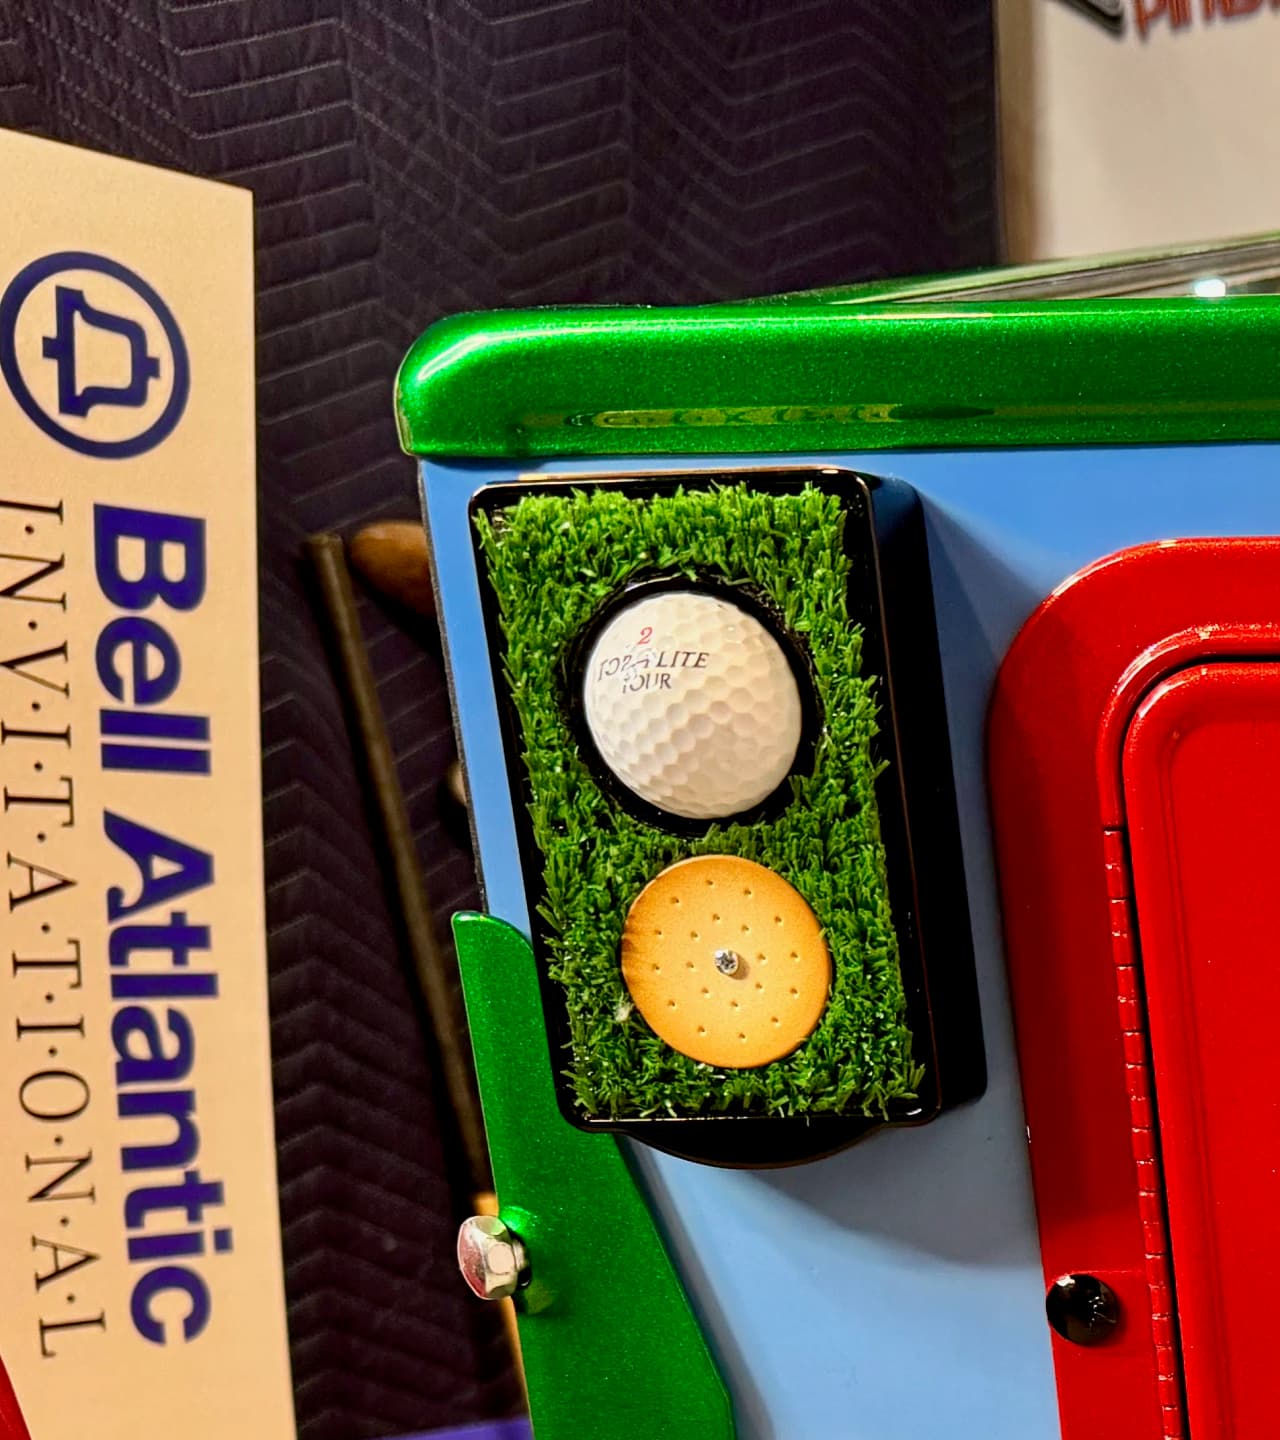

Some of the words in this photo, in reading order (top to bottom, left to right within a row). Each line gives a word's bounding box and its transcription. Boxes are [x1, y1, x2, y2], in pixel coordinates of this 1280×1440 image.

[93, 502, 212, 777] Bell
[637, 626, 653, 645] 2
[102, 806, 234, 1347] Atlantic
